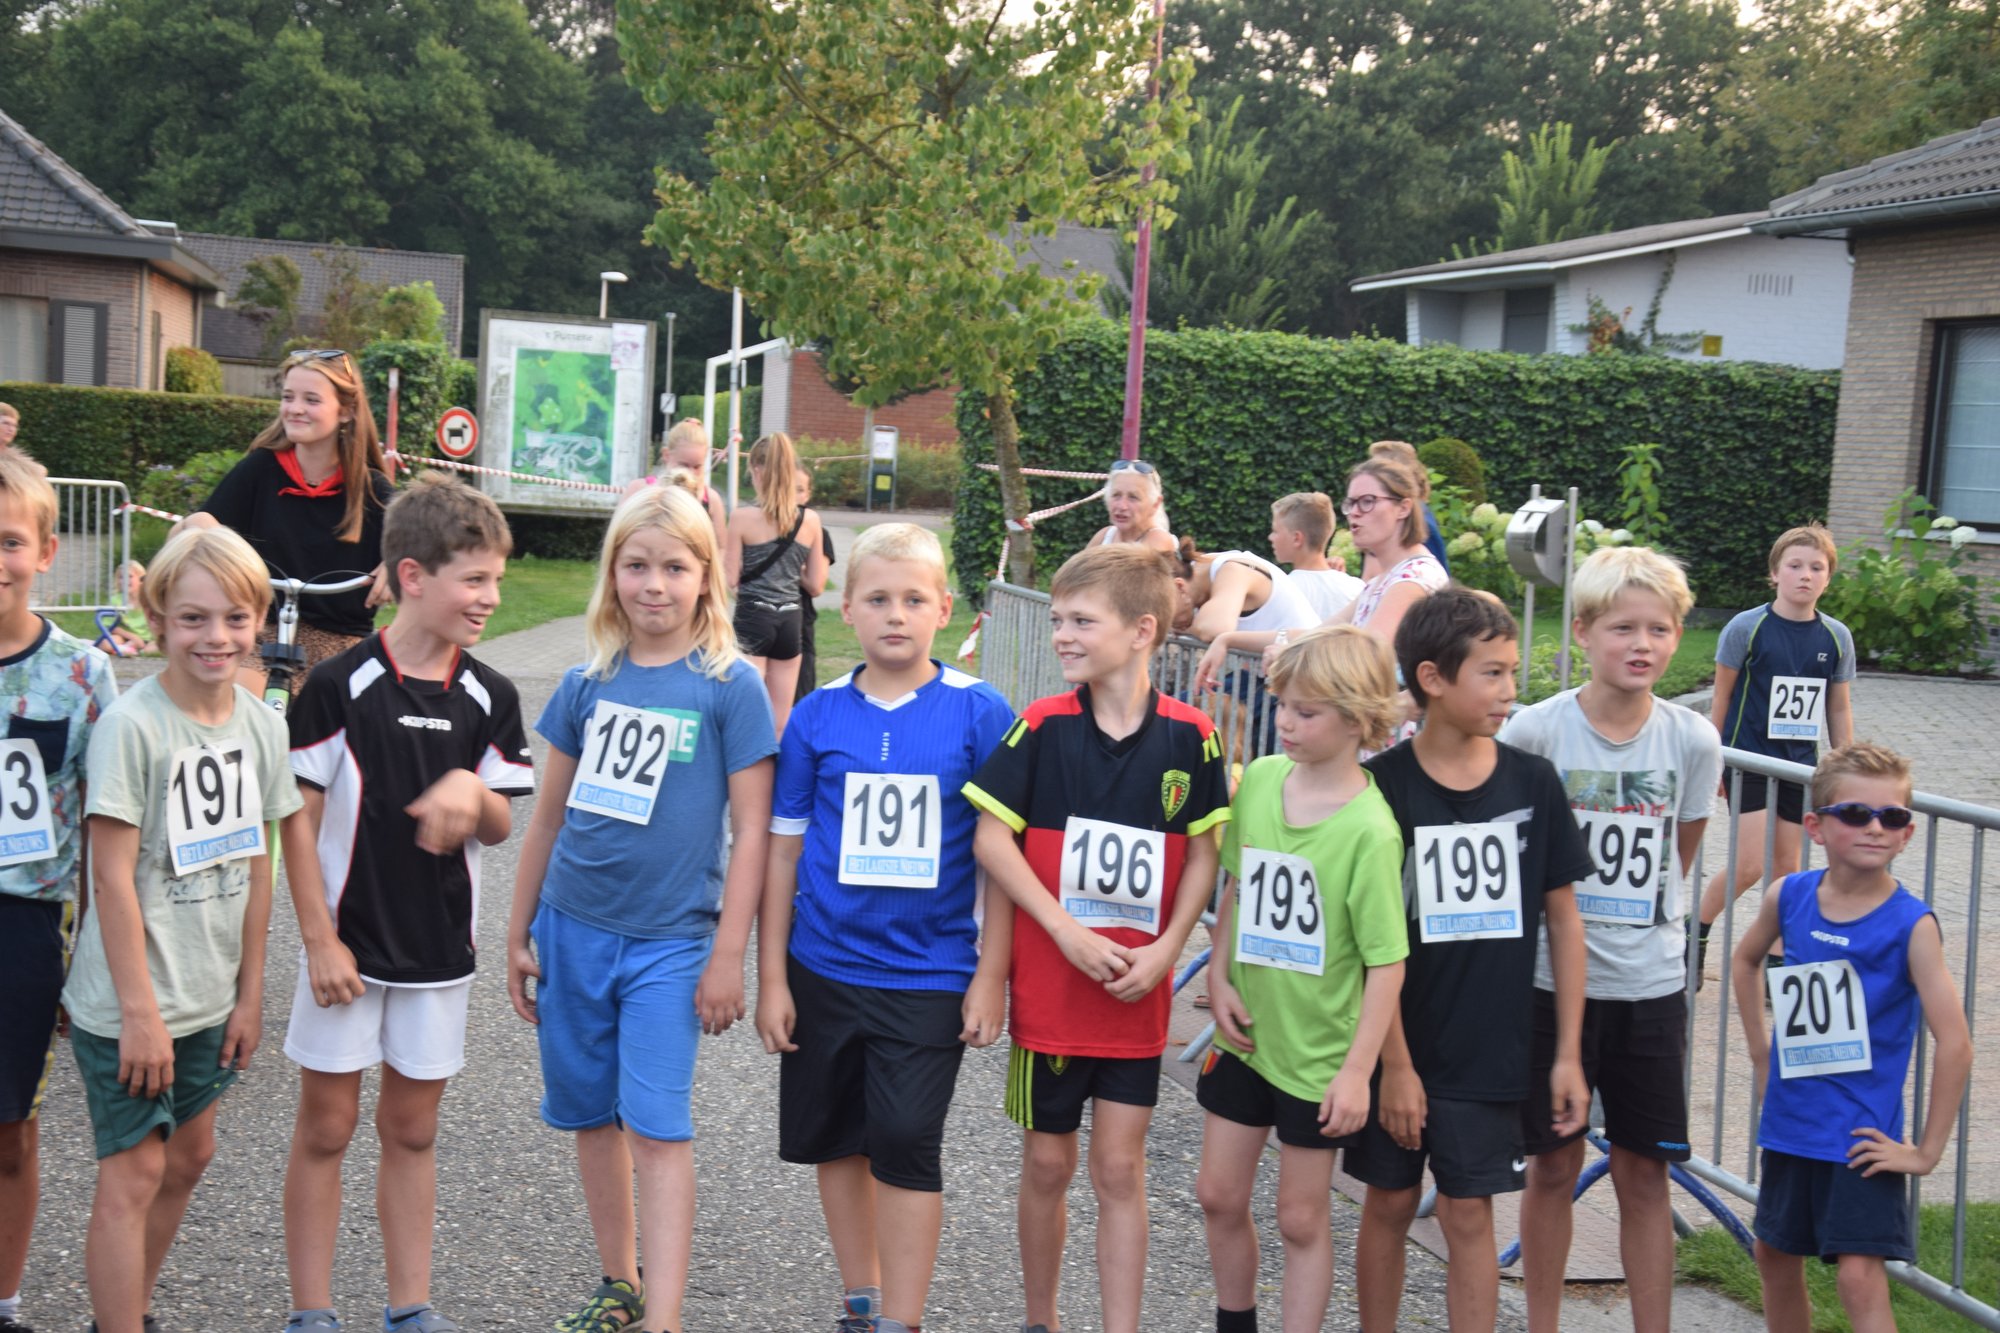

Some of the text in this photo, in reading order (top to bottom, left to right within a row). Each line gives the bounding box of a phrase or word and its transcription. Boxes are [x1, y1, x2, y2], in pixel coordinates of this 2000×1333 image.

[1773, 683, 1821, 720] 257
[594, 714, 665, 787] 192
[174, 749, 243, 830] 197
[853, 783, 927, 847] 191
[1072, 829, 1153, 898] 196
[1250, 861, 1319, 935] 193
[1424, 834, 1507, 903] 199
[1782, 968, 1856, 1037] 201
